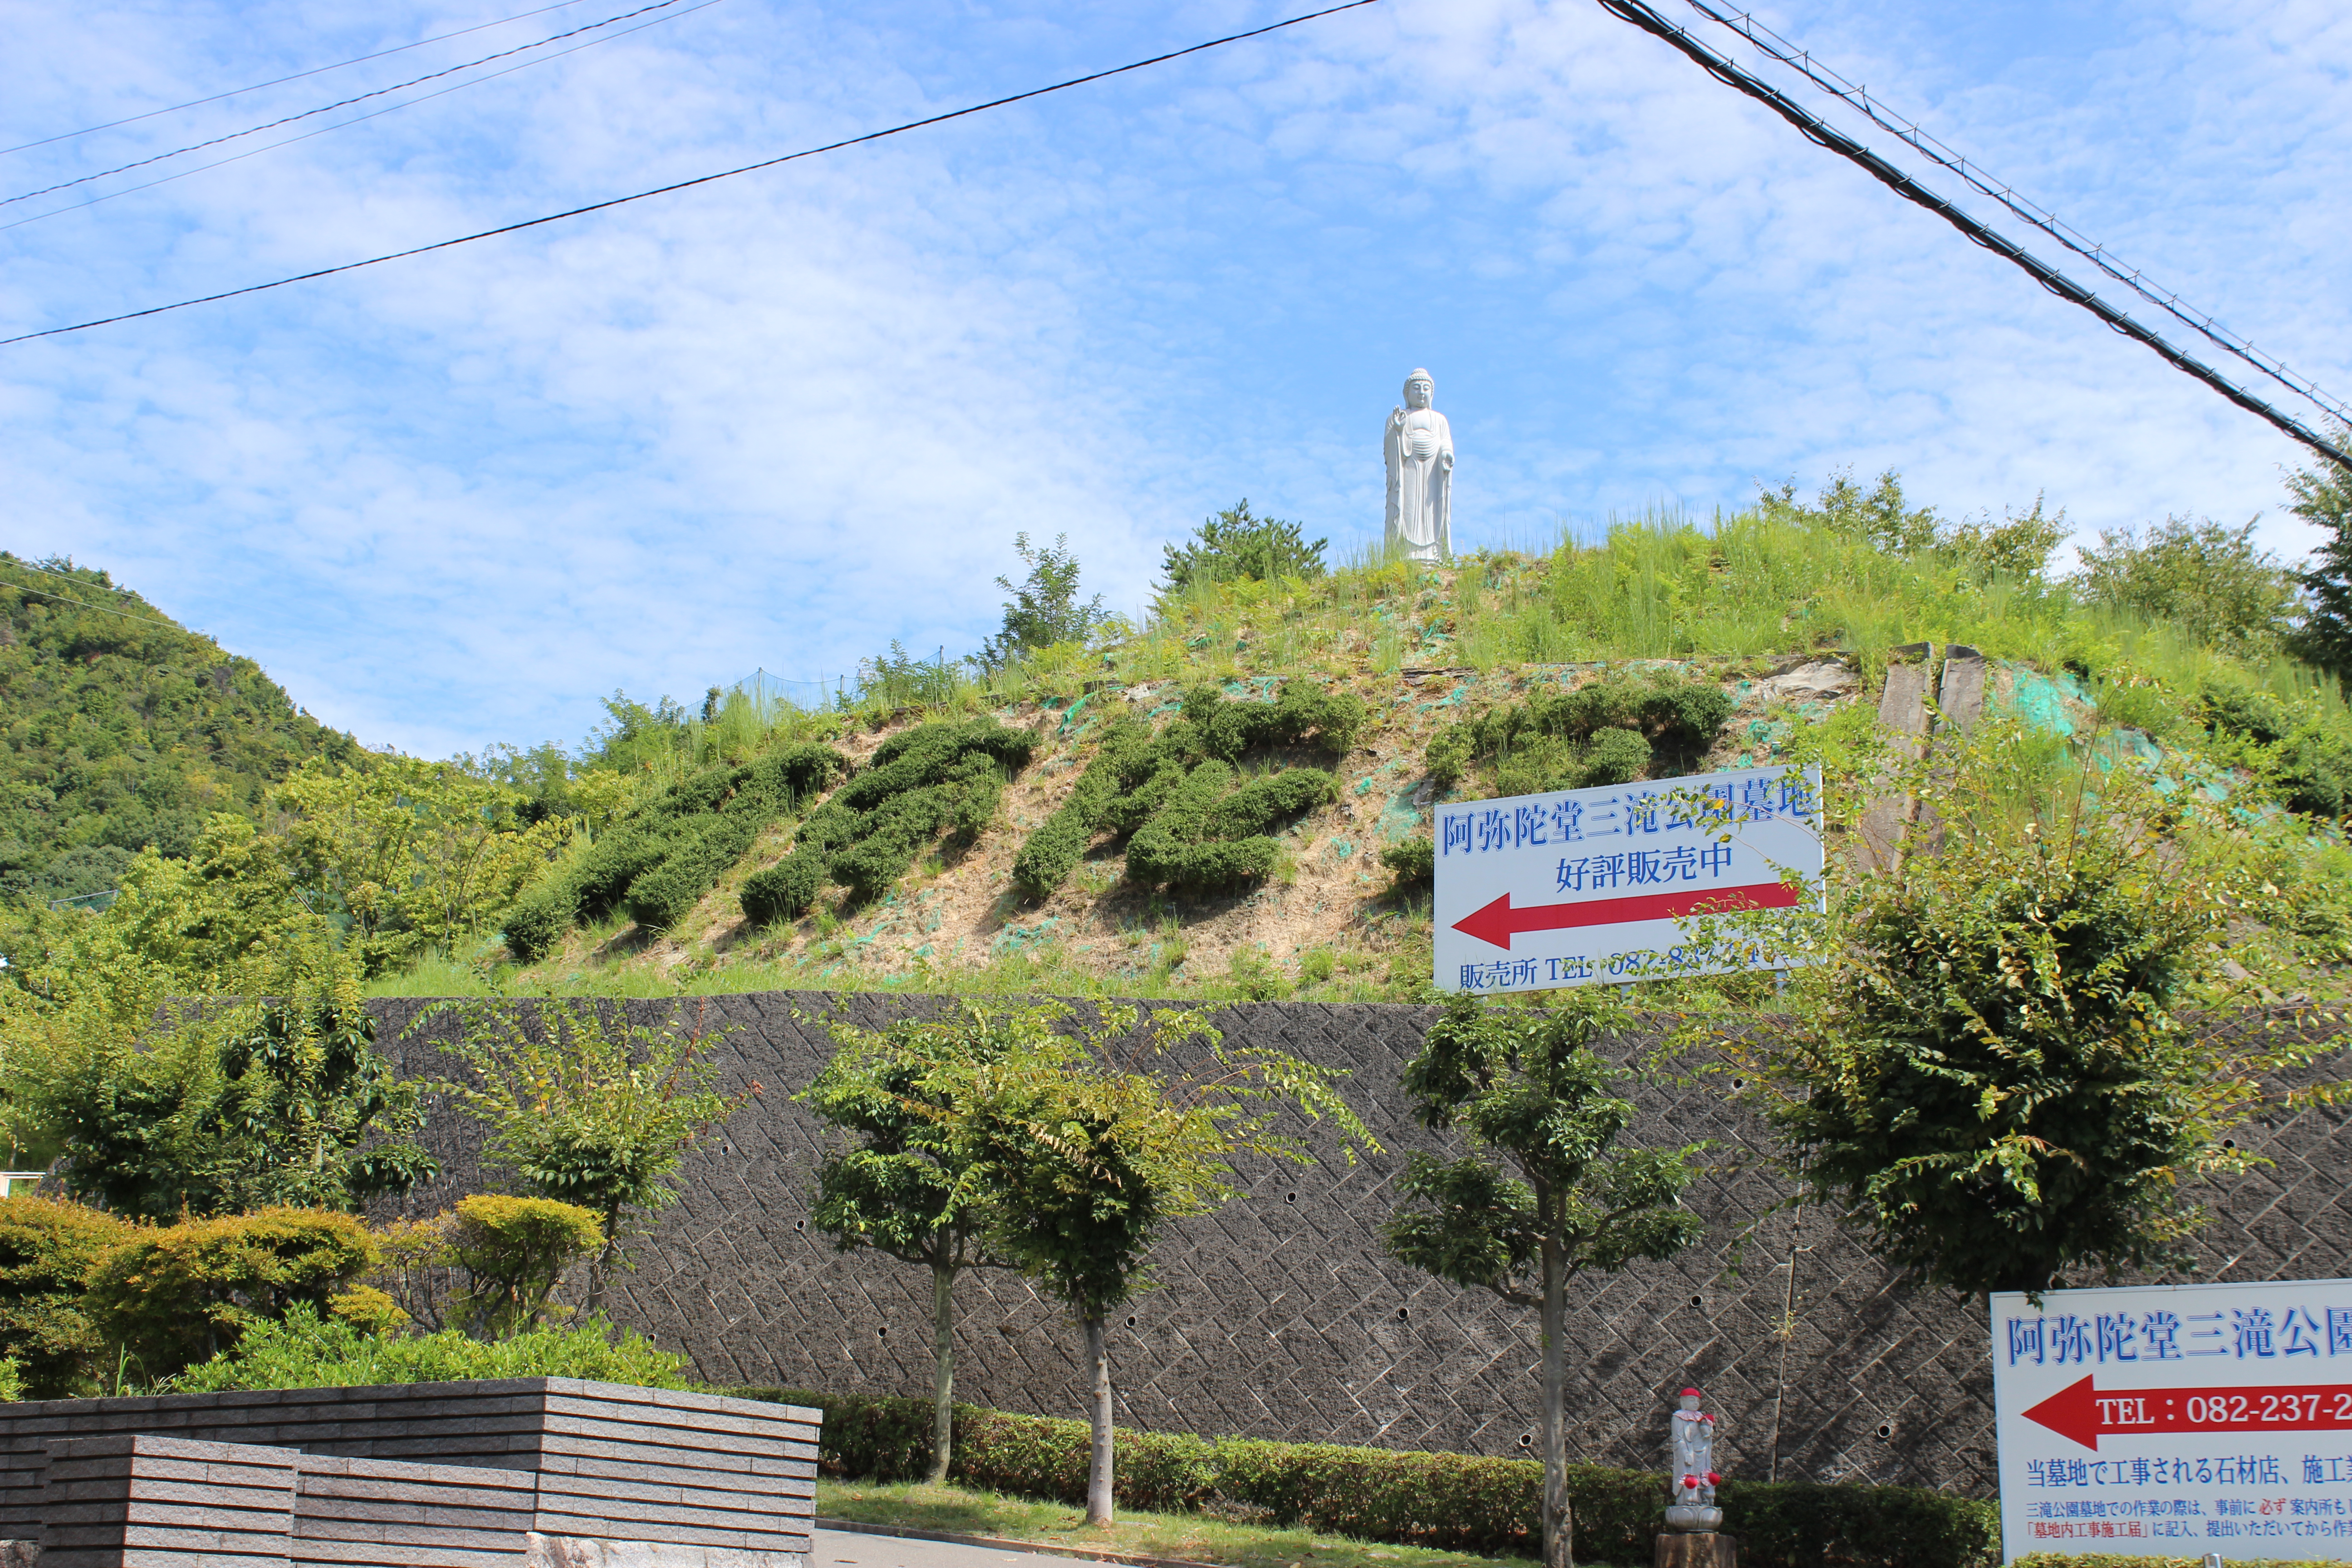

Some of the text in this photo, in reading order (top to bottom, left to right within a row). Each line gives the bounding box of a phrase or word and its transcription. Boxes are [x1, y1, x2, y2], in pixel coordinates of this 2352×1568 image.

[1556, 842, 1732, 893] 好評販売中
[1460, 957, 1538, 989] 販売所
[1545, 956, 1592, 980] TEL
